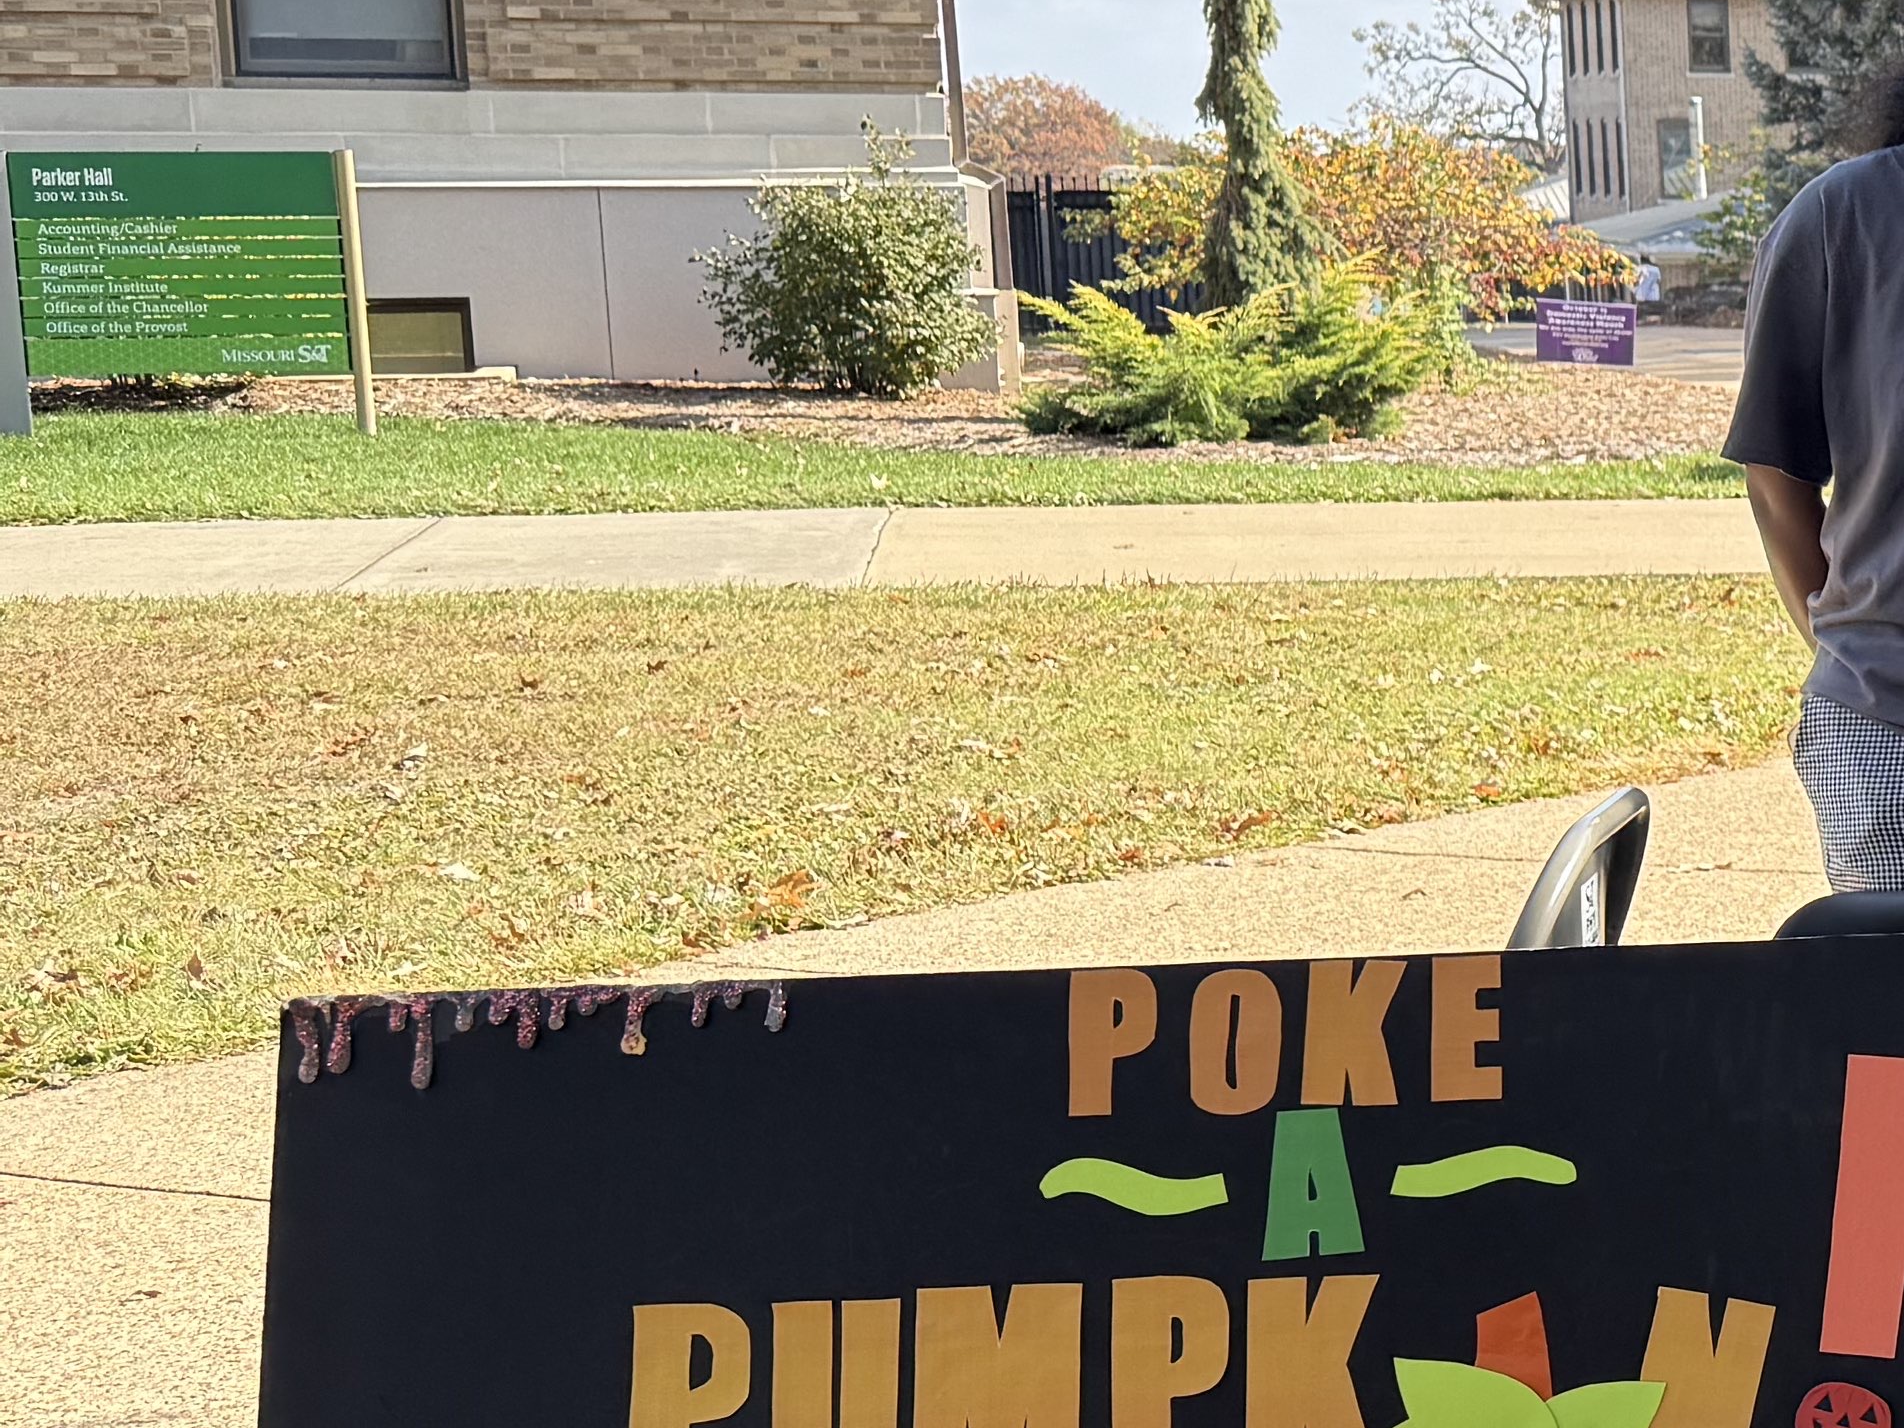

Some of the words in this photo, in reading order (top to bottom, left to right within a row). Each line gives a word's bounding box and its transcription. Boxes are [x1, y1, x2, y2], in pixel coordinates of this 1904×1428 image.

[31, 167, 81, 187] Parker
[84, 167, 113, 186] Hall
[34, 191, 58, 202] 300
[60, 191, 77, 202] W.
[81, 191, 108, 202] 13th
[111, 190, 129, 202] St.
[38, 222, 178, 237] Accounting/Cashier
[38, 243, 94, 255] Student
[99, 243, 164, 255] Financial
[167, 242, 242, 254] Assistance
[40, 262, 105, 276] Registrar
[42, 282, 104, 294] Kummer
[107, 281, 168, 293] Institute
[44, 302, 86, 314] Office
[89, 302, 103, 314] of
[106, 302, 130, 314] the
[132, 302, 209, 314] Chancellor
[46, 322, 88, 334] Office
[91, 322, 106, 334] of
[108, 322, 132, 334] the
[135, 321, 188, 333] Provost
[298, 344, 331, 363] S&T
[1067, 954, 1503, 1118] POKE
[1262, 1108, 1367, 1263] A
